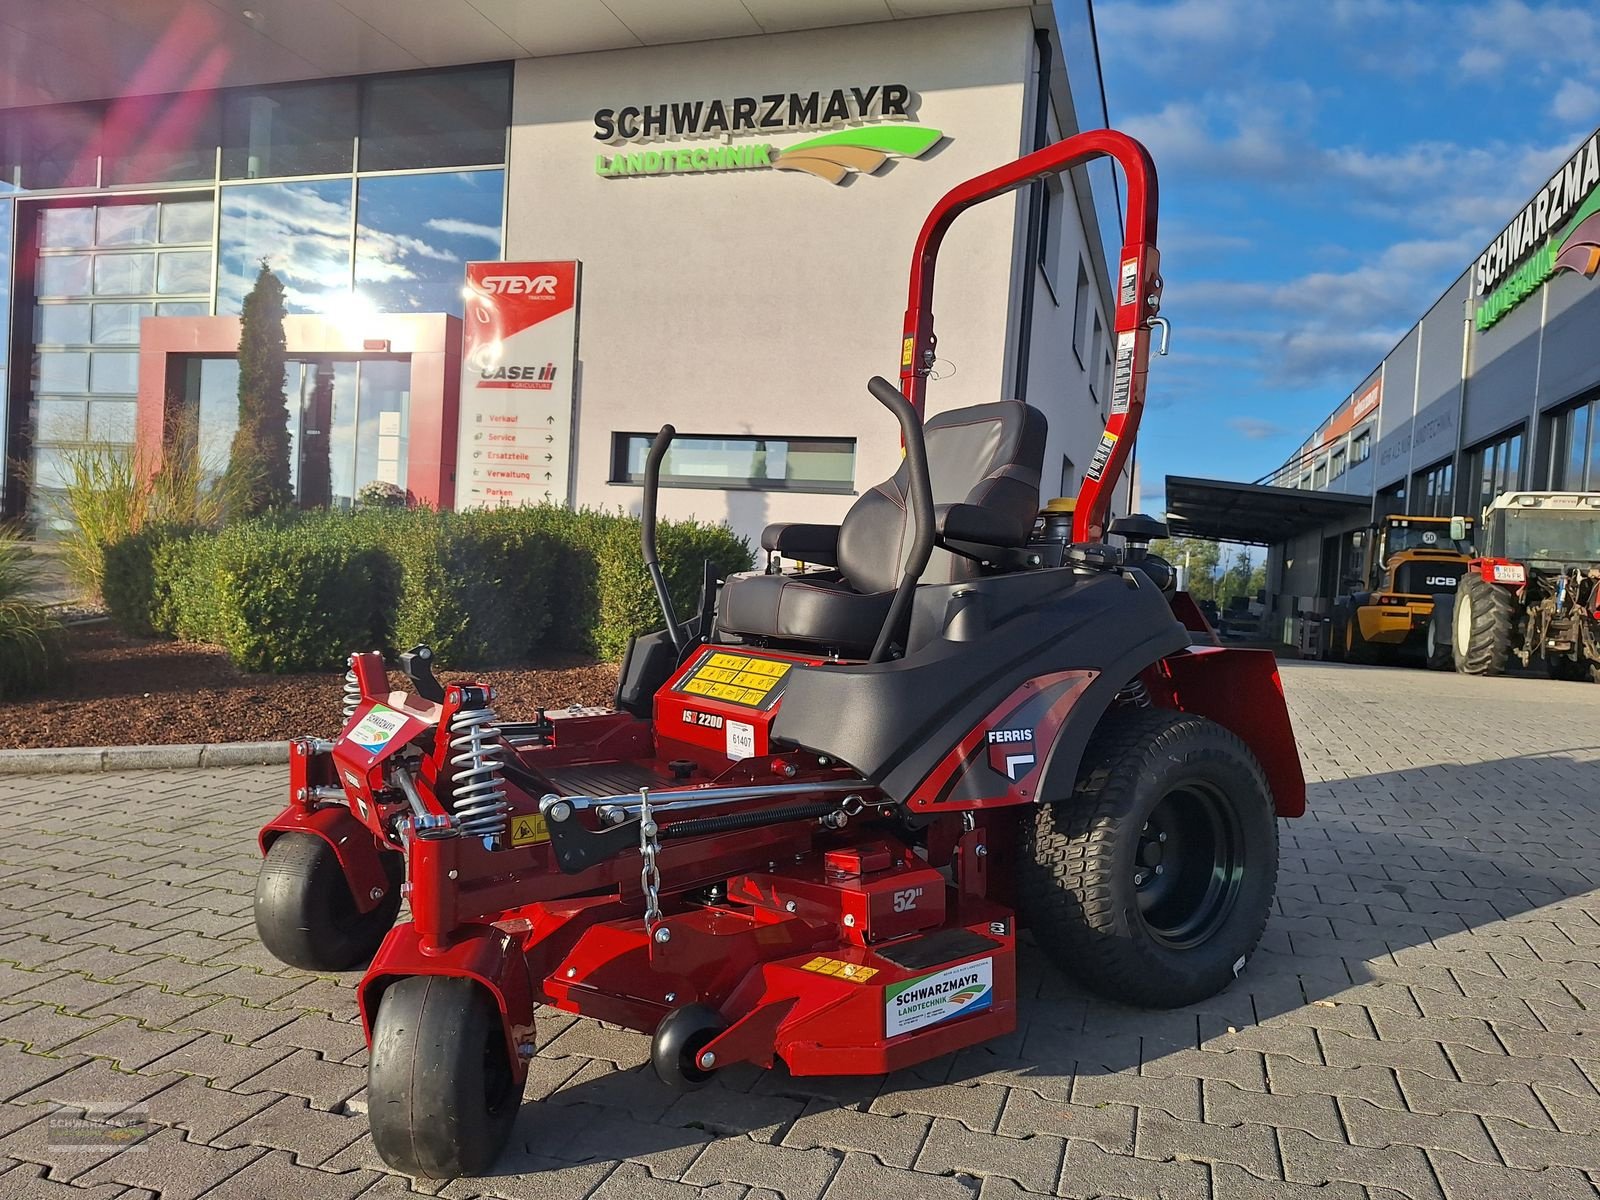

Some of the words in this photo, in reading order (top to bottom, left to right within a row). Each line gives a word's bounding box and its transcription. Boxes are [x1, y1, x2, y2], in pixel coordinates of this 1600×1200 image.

[593, 84, 909, 140] SCHWARZMAYR
[595, 144, 771, 174] LANDTECHNIK
[481, 275, 558, 294] STEYR
[481, 366, 535, 380] CASE
[489, 415, 518, 423] Verkauf
[488, 433, 516, 442] Service
[487, 451, 529, 461] Ersatzteile
[487, 470, 531, 481] Verwaltung
[486, 487, 513, 496] Parken
[1425, 576, 1457, 586] JCB
[698, 713, 723, 729] 2200
[732, 734, 752, 748] 61407
[988, 729, 1033, 743] FERRIS
[896, 973, 979, 1006] SCHWARZMAYR
[898, 996, 947, 1016] LANDTECHNIK
